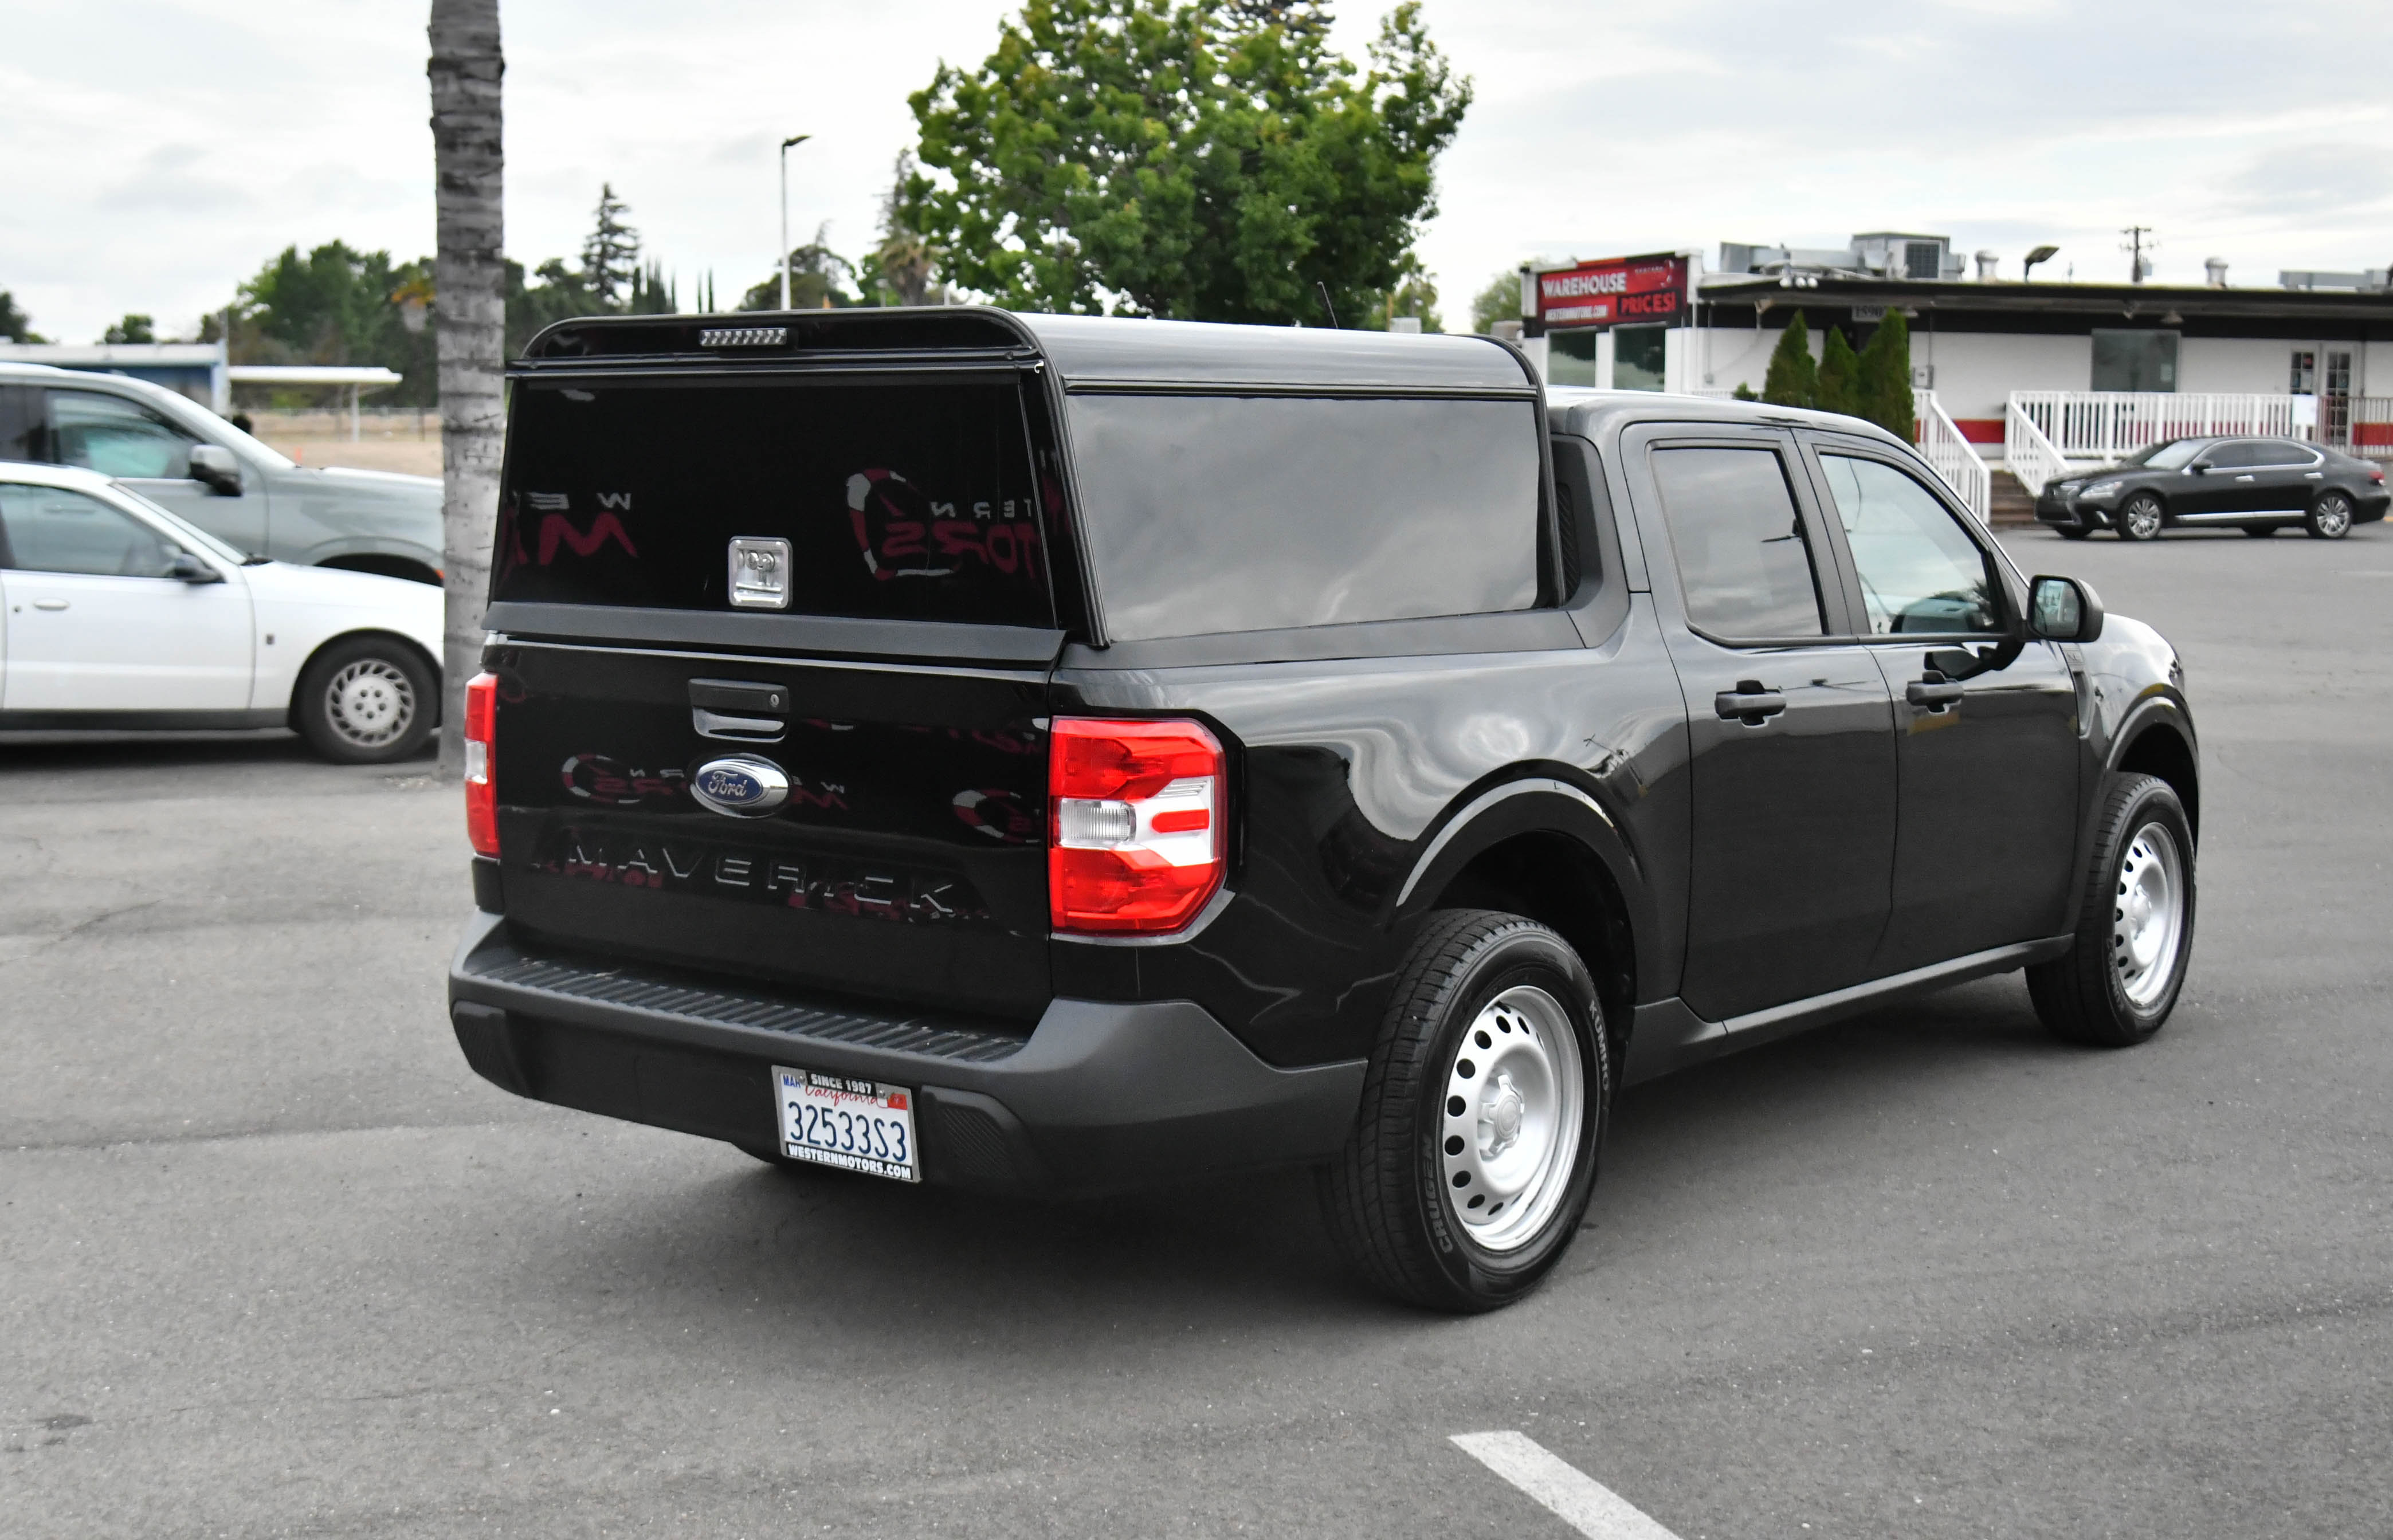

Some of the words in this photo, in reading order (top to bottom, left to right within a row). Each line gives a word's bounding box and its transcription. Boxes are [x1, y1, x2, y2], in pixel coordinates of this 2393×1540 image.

[1541, 272, 1627, 297] WAREHOUSE
[708, 770, 748, 797] Ford
[568, 844, 954, 913] MAVERICK
[1589, 999, 1609, 1091] KUMHO
[805, 1085, 888, 1108] California
[811, 1074, 842, 1089] SINCE
[846, 1079, 872, 1095] 1987
[788, 1101, 907, 1162] 32533S3
[788, 1144, 911, 1180] WESTERNMOTORS.COM
[1422, 1133, 1453, 1254] CRUGEN
